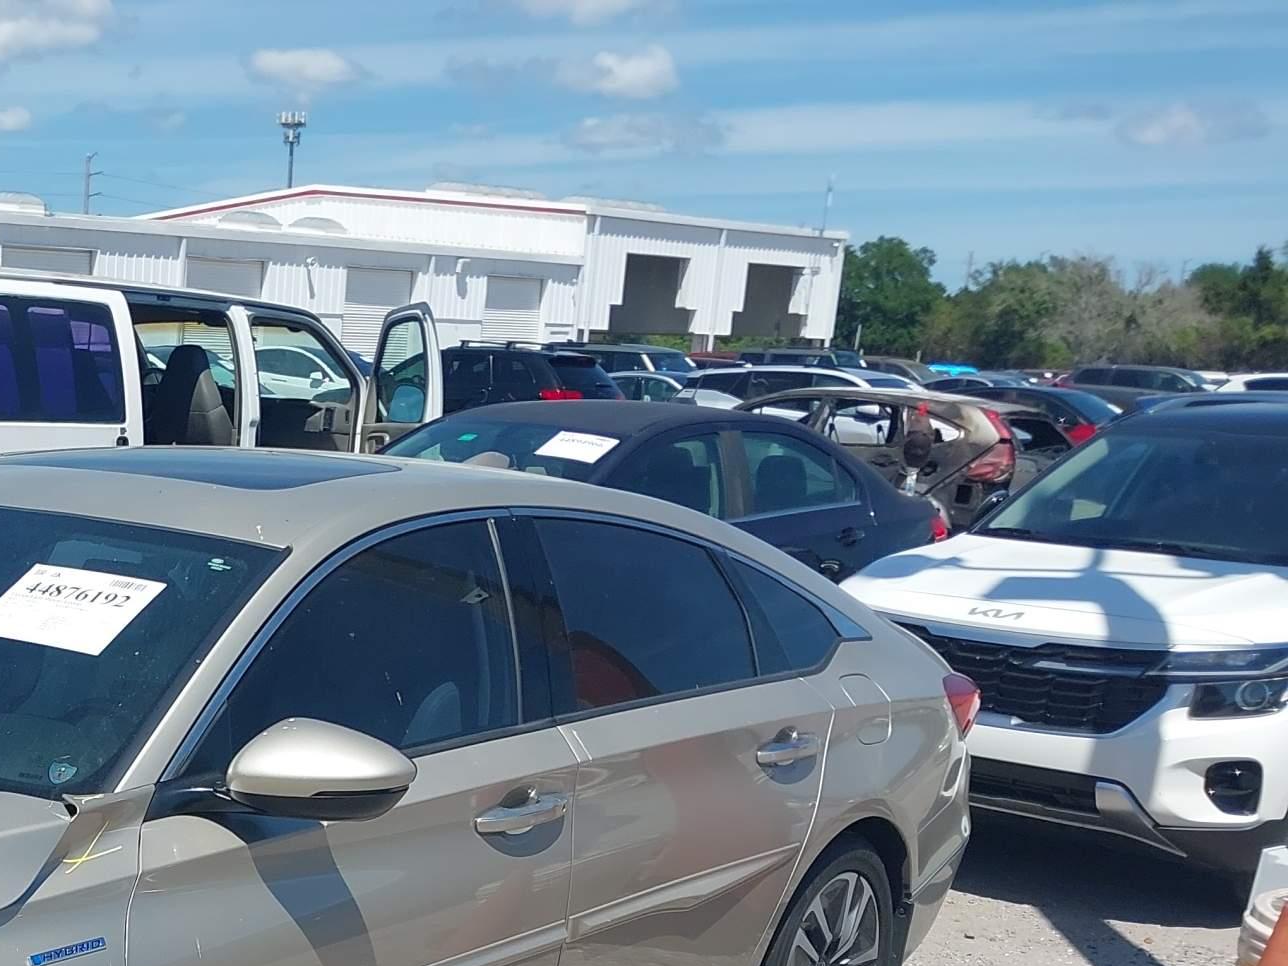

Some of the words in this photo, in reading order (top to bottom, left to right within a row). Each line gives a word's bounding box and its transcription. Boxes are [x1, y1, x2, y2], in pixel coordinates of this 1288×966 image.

[25, 581, 131, 608] 44876192
[968, 607, 1024, 620] KIA
[40, 937, 103, 963] HYBRID
